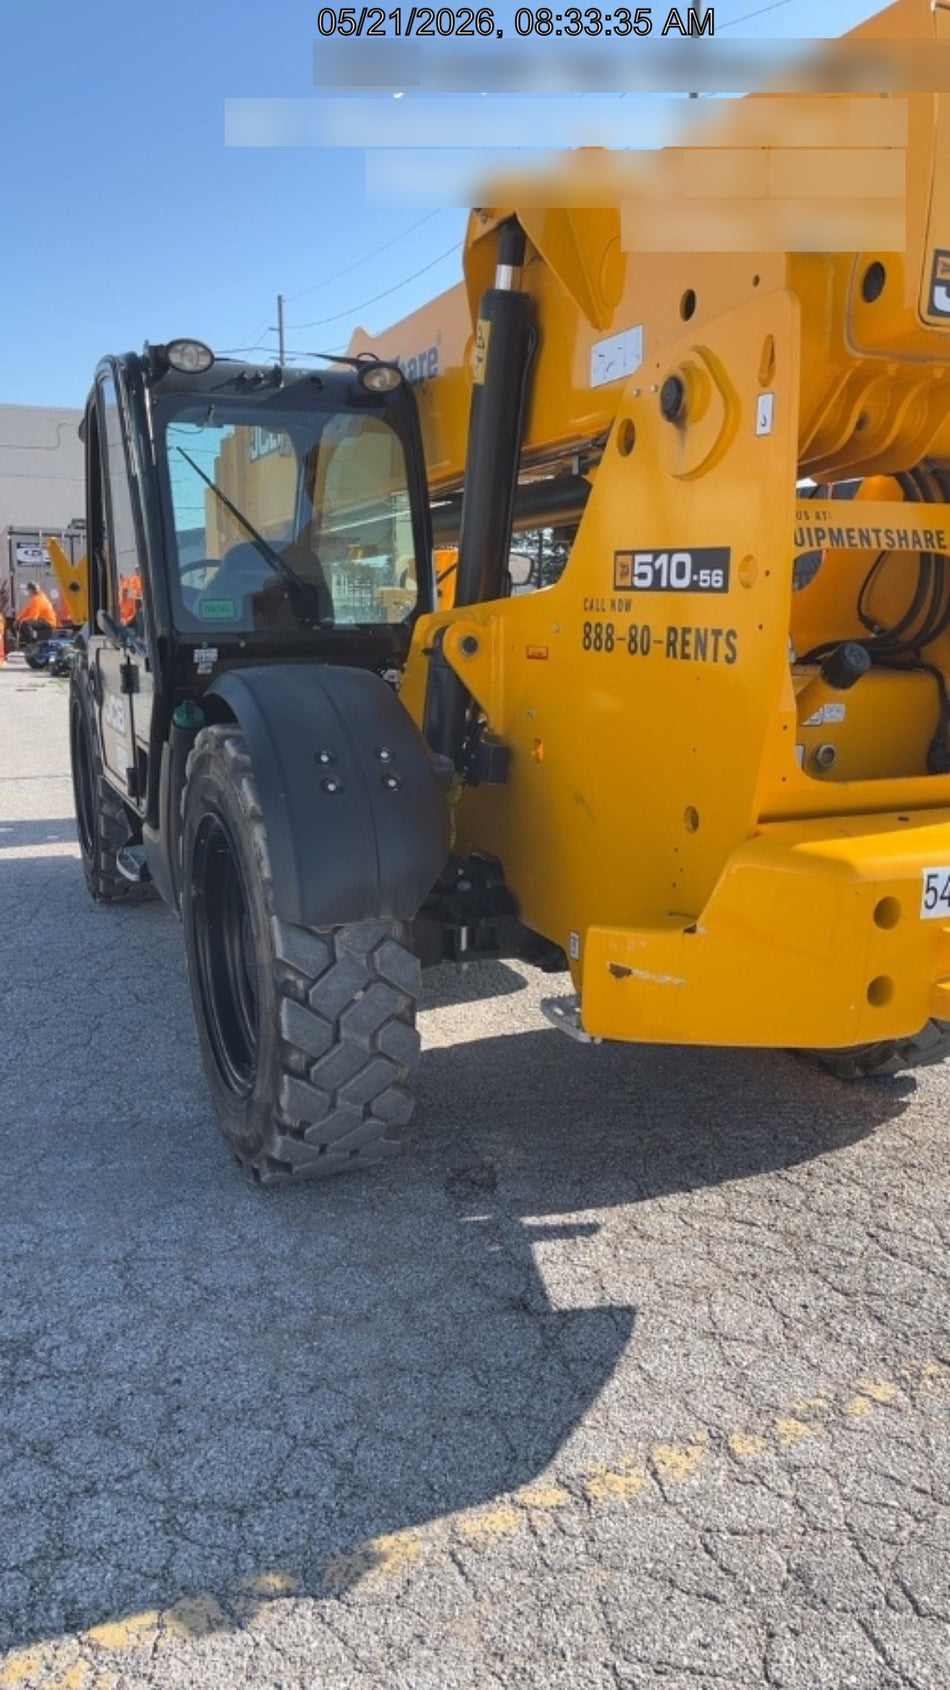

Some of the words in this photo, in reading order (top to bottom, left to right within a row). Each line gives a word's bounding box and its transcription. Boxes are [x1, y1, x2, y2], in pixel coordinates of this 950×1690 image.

[633, 552, 723, 588] 510-56
[583, 597, 606, 612] CALL
[582, 621, 738, 665] 888-80-RENTS
